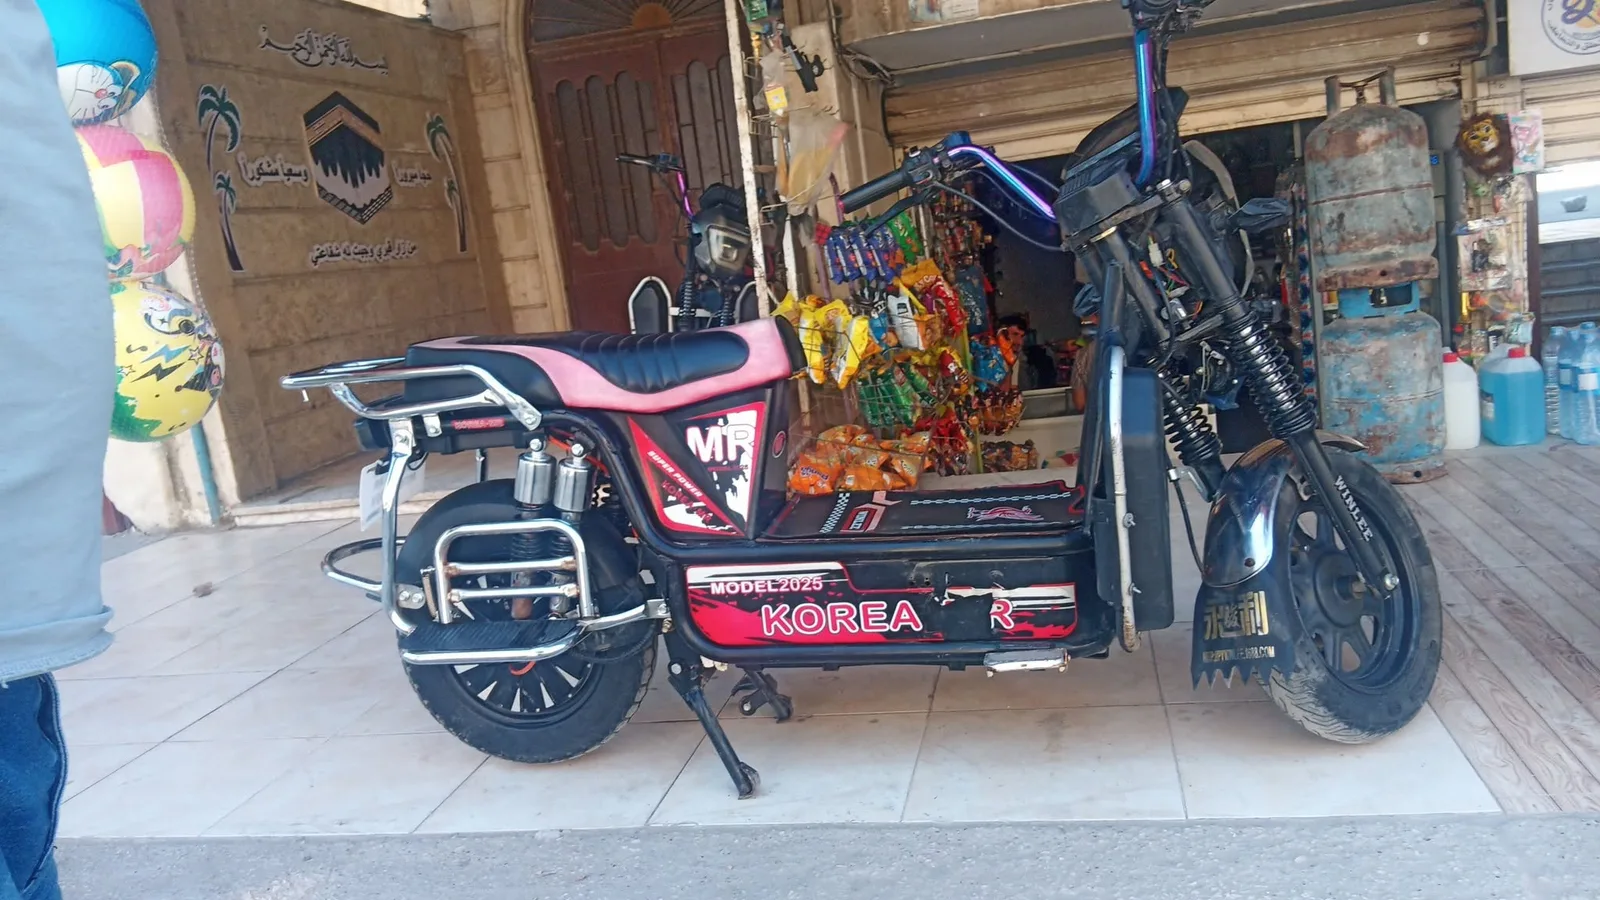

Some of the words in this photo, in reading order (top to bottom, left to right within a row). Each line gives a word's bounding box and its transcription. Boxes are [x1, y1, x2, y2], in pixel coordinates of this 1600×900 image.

[686, 424, 756, 463] MR
[647, 450, 676, 474] SUPER
[673, 472, 704, 498] POWER
[1333, 474, 1374, 542] WINLEE
[760, 599, 924, 636] KOREA
